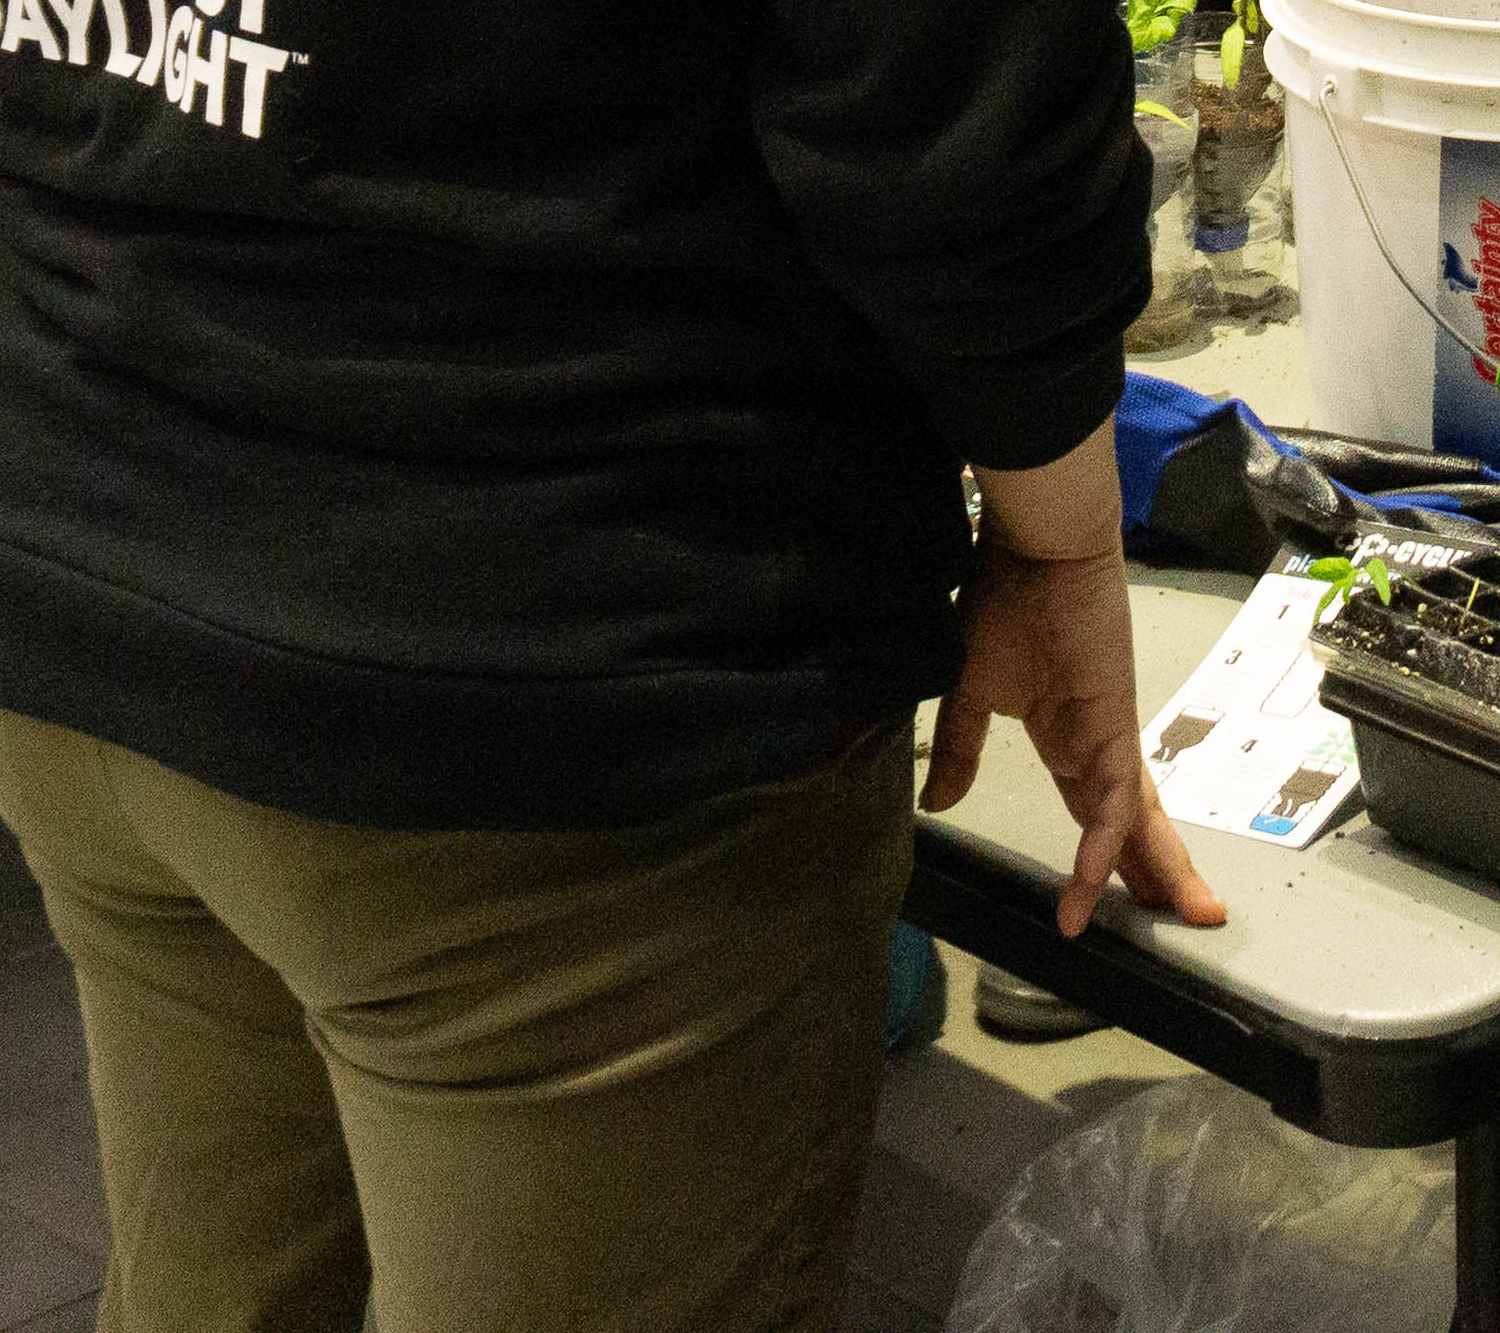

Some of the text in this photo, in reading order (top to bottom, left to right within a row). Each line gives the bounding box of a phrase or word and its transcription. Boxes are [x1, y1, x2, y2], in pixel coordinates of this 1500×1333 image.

[1277, 604, 1291, 620] 1
[1224, 649, 1244, 666] 3
[1240, 738, 1258, 753] 4
